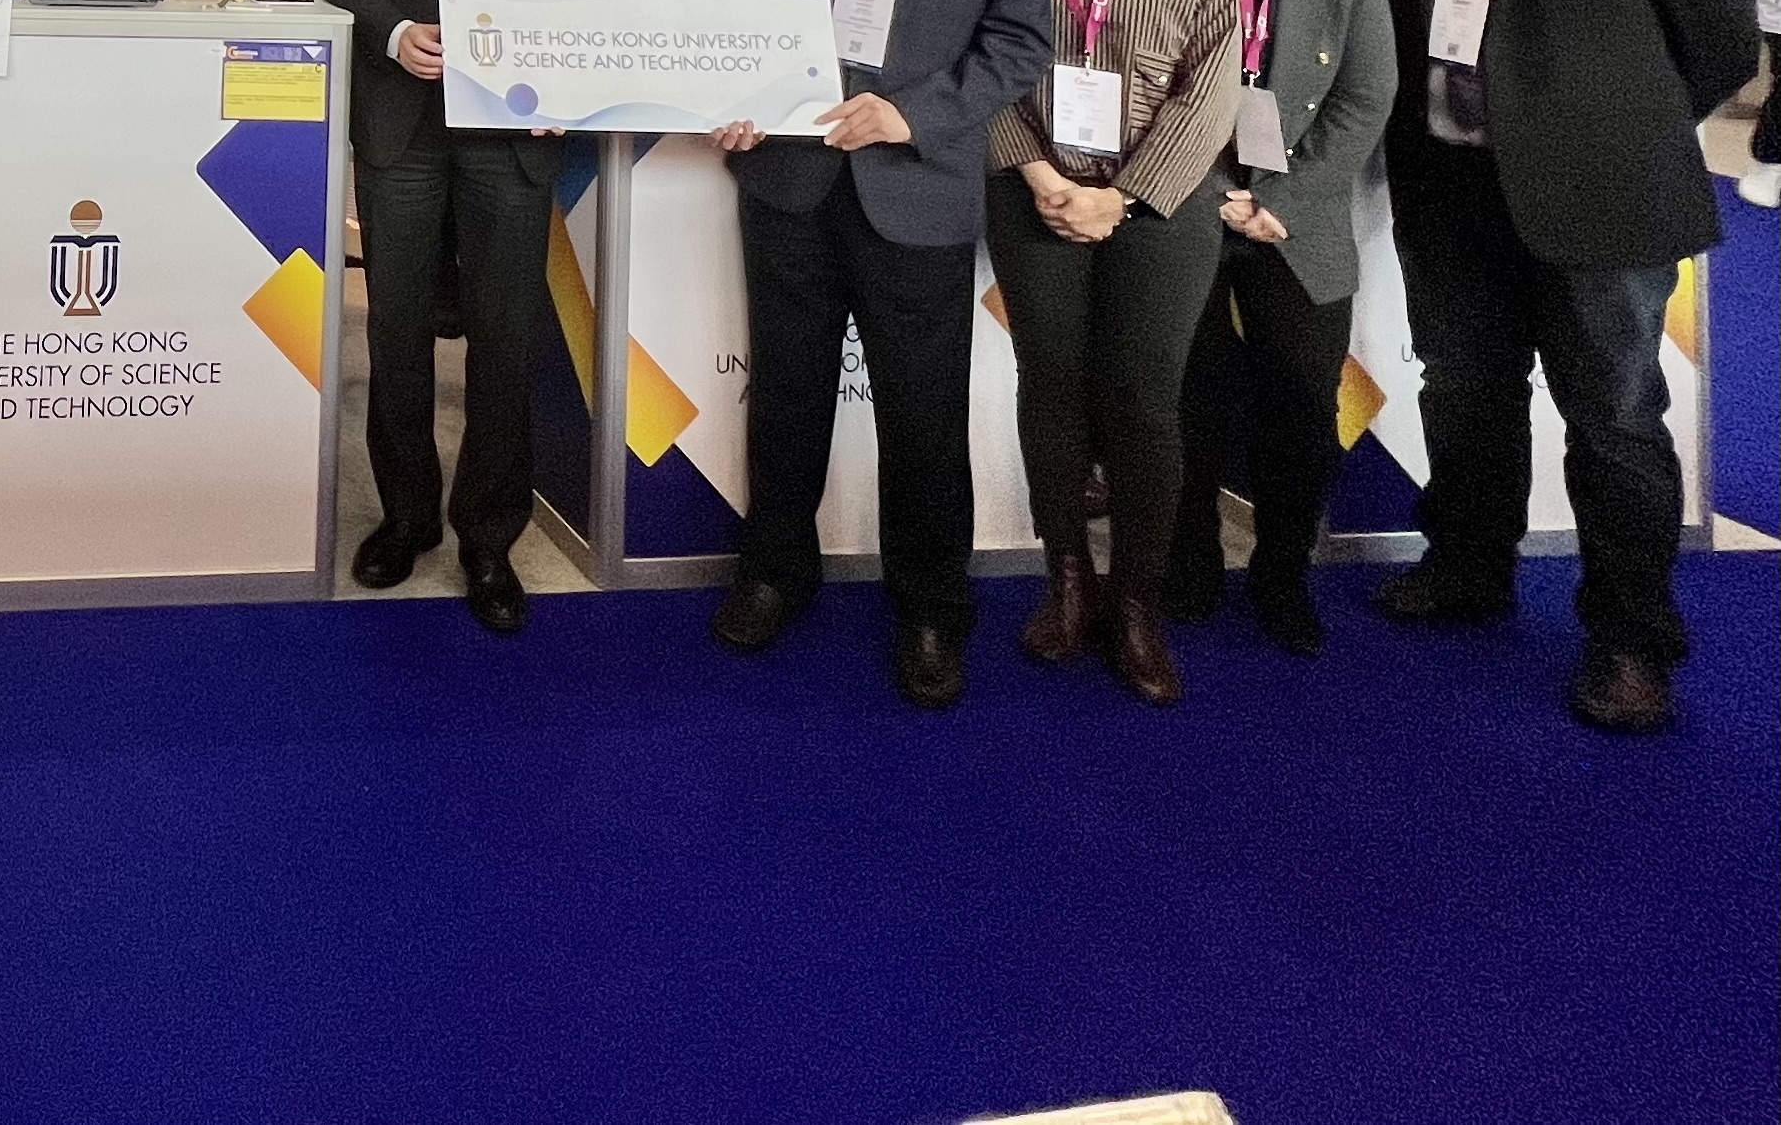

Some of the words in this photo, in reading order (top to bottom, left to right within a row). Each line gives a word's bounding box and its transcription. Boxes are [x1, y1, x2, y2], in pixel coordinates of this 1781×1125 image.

[512, 30, 543, 46] THE
[549, 31, 606, 47] HONG
[612, 31, 668, 48] KONG
[674, 33, 771, 50] UNIVERSITY
[778, 34, 802, 51] OF
[513, 52, 588, 69] SCIENCE
[594, 53, 634, 70] AND
[640, 55, 762, 73] TECHNOLOGY
[24, 332, 104, 355] HONG
[112, 331, 188, 353] KONG
[80, 364, 114, 386] OF
[122, 362, 222, 385] SCIENCE
[26, 394, 195, 419] TECHNOLOGY
